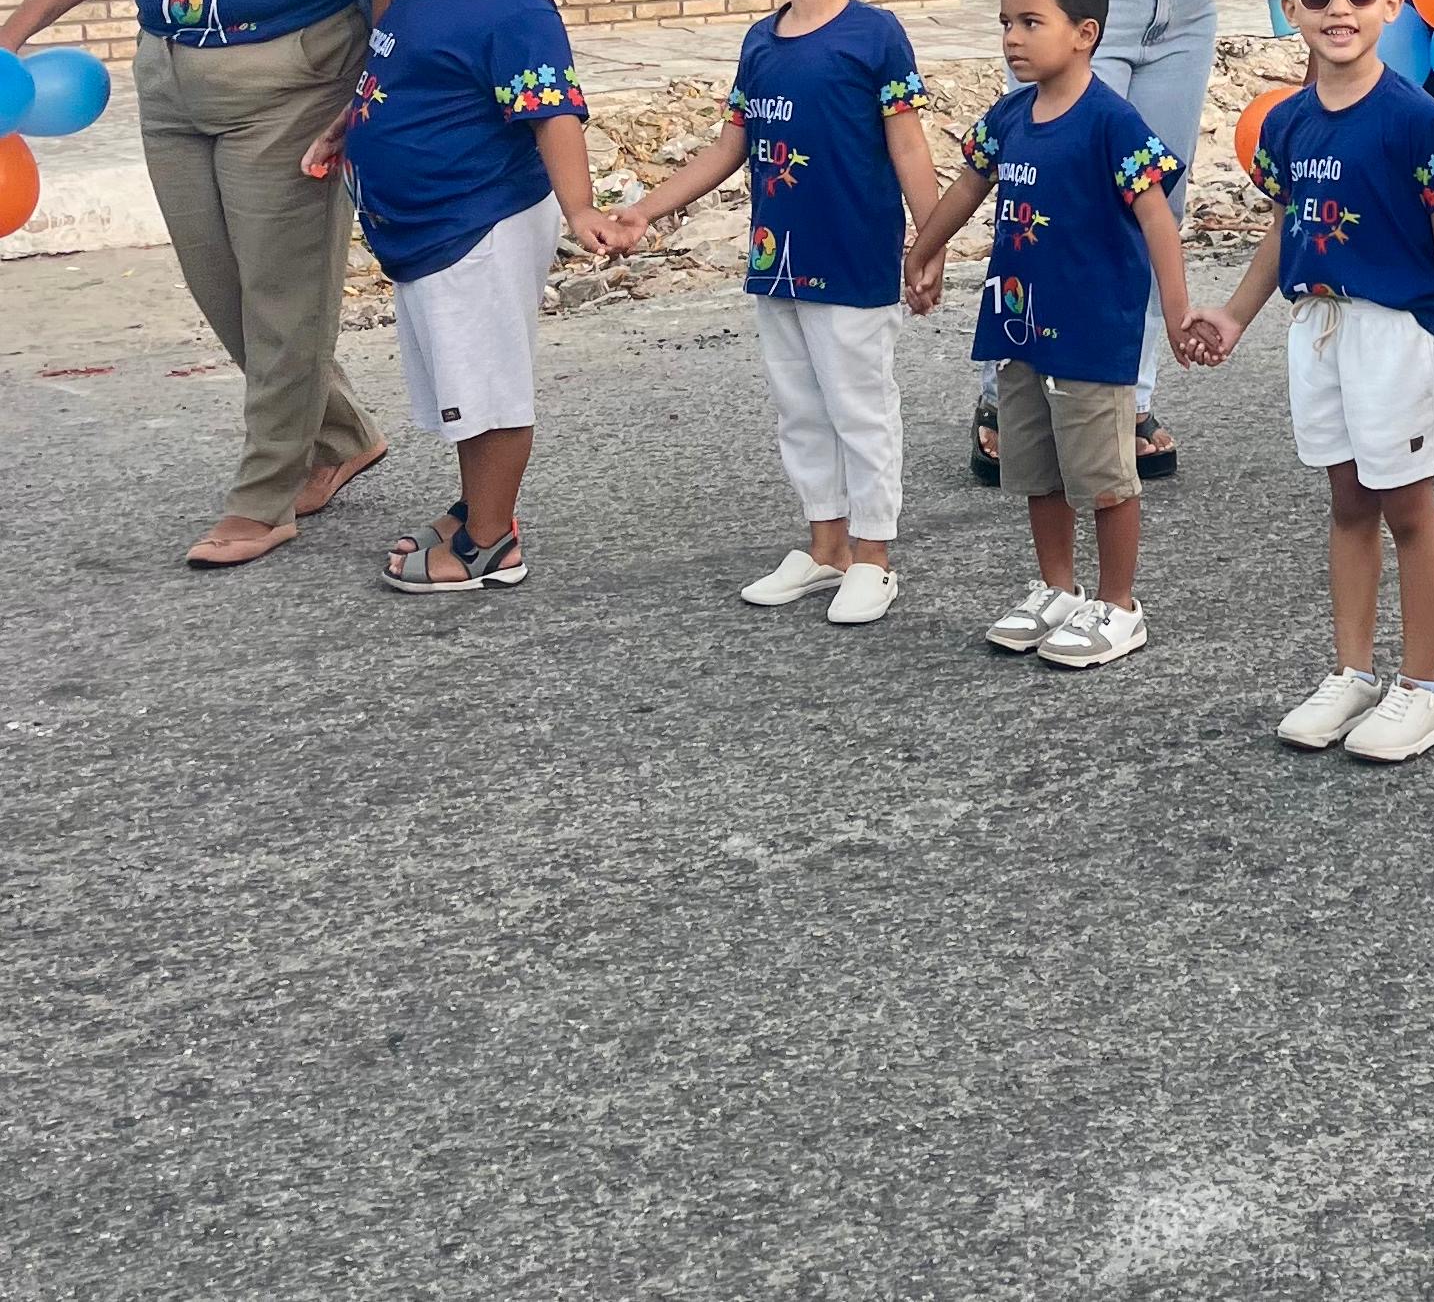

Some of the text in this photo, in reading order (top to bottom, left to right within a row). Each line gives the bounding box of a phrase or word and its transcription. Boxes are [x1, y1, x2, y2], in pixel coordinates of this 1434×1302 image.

[758, 138, 788, 166] ELO
[1000, 199, 1032, 225] ELO
[1303, 198, 1340, 224] ELO
